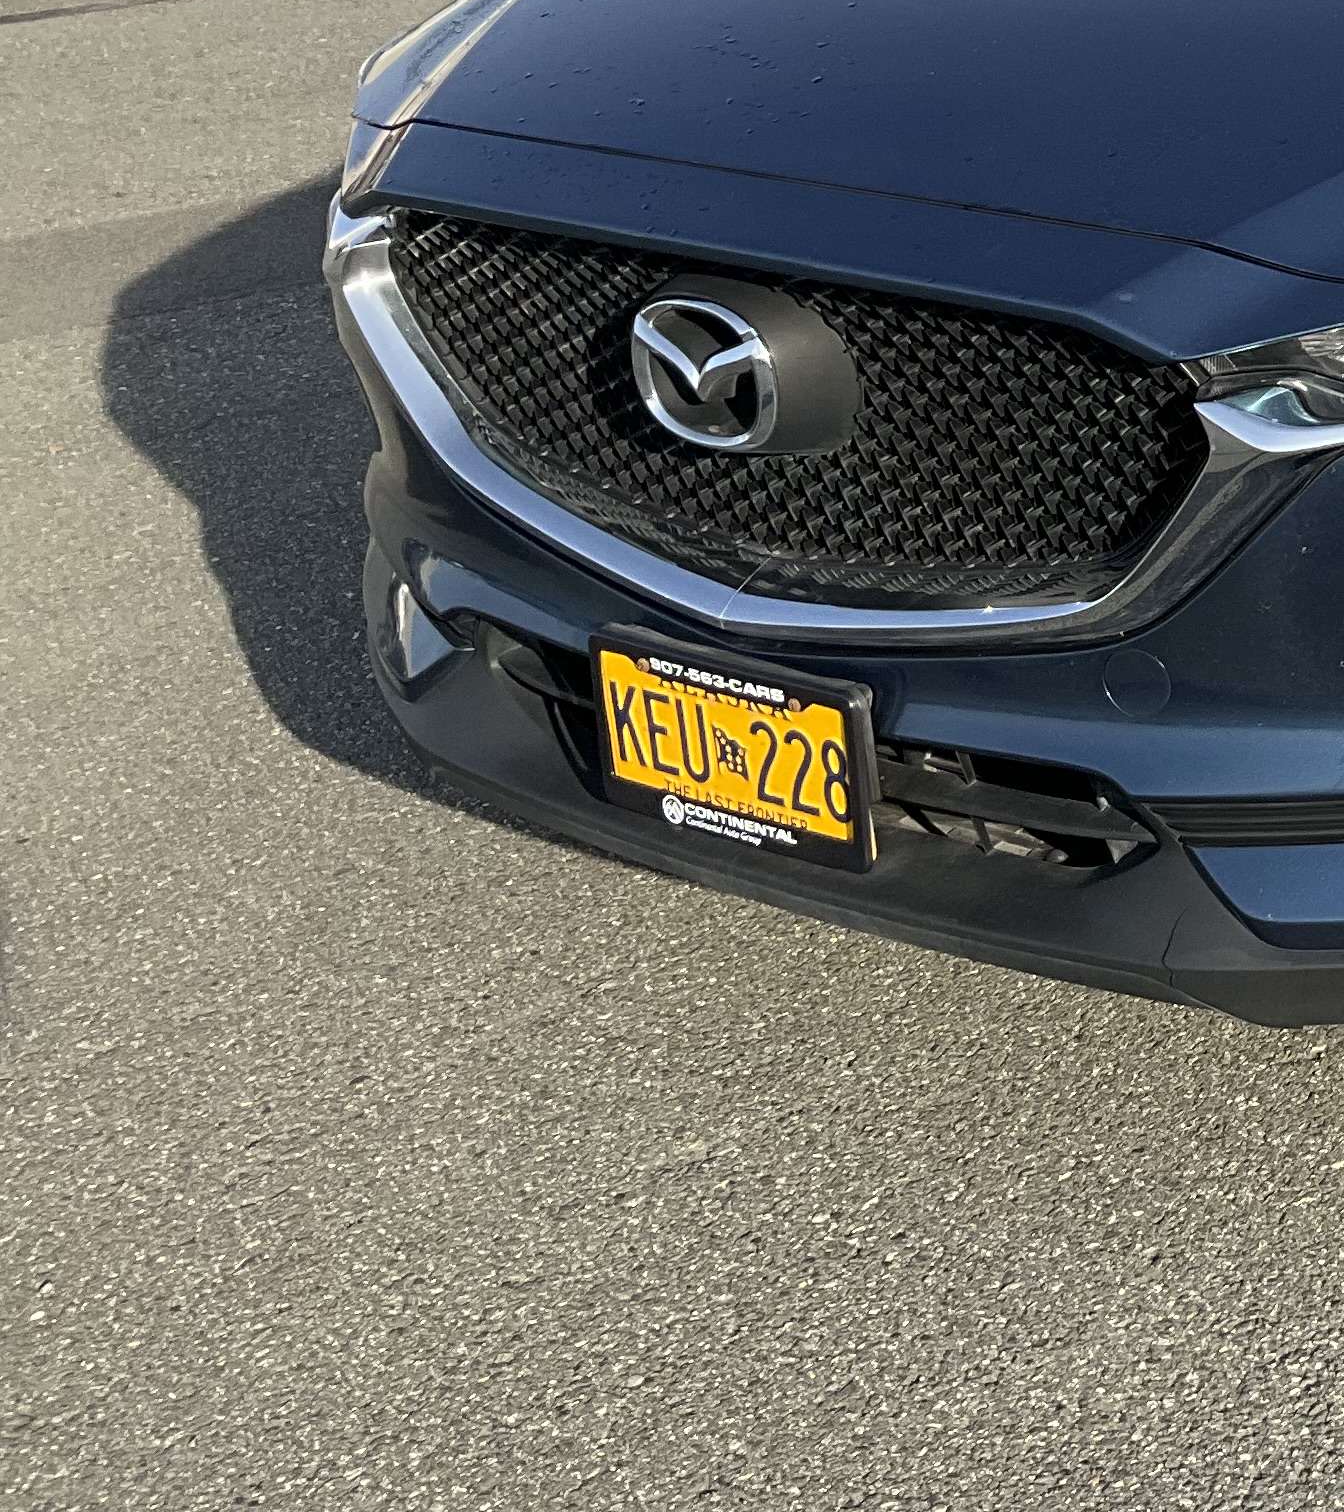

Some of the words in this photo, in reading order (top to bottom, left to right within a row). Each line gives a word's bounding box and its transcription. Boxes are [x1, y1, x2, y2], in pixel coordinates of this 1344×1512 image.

[649, 657, 785, 703] 907-563-CARS
[609, 680, 711, 784] KEU
[750, 720, 851, 824] 228
[684, 802, 798, 845] CONTINENTAL
